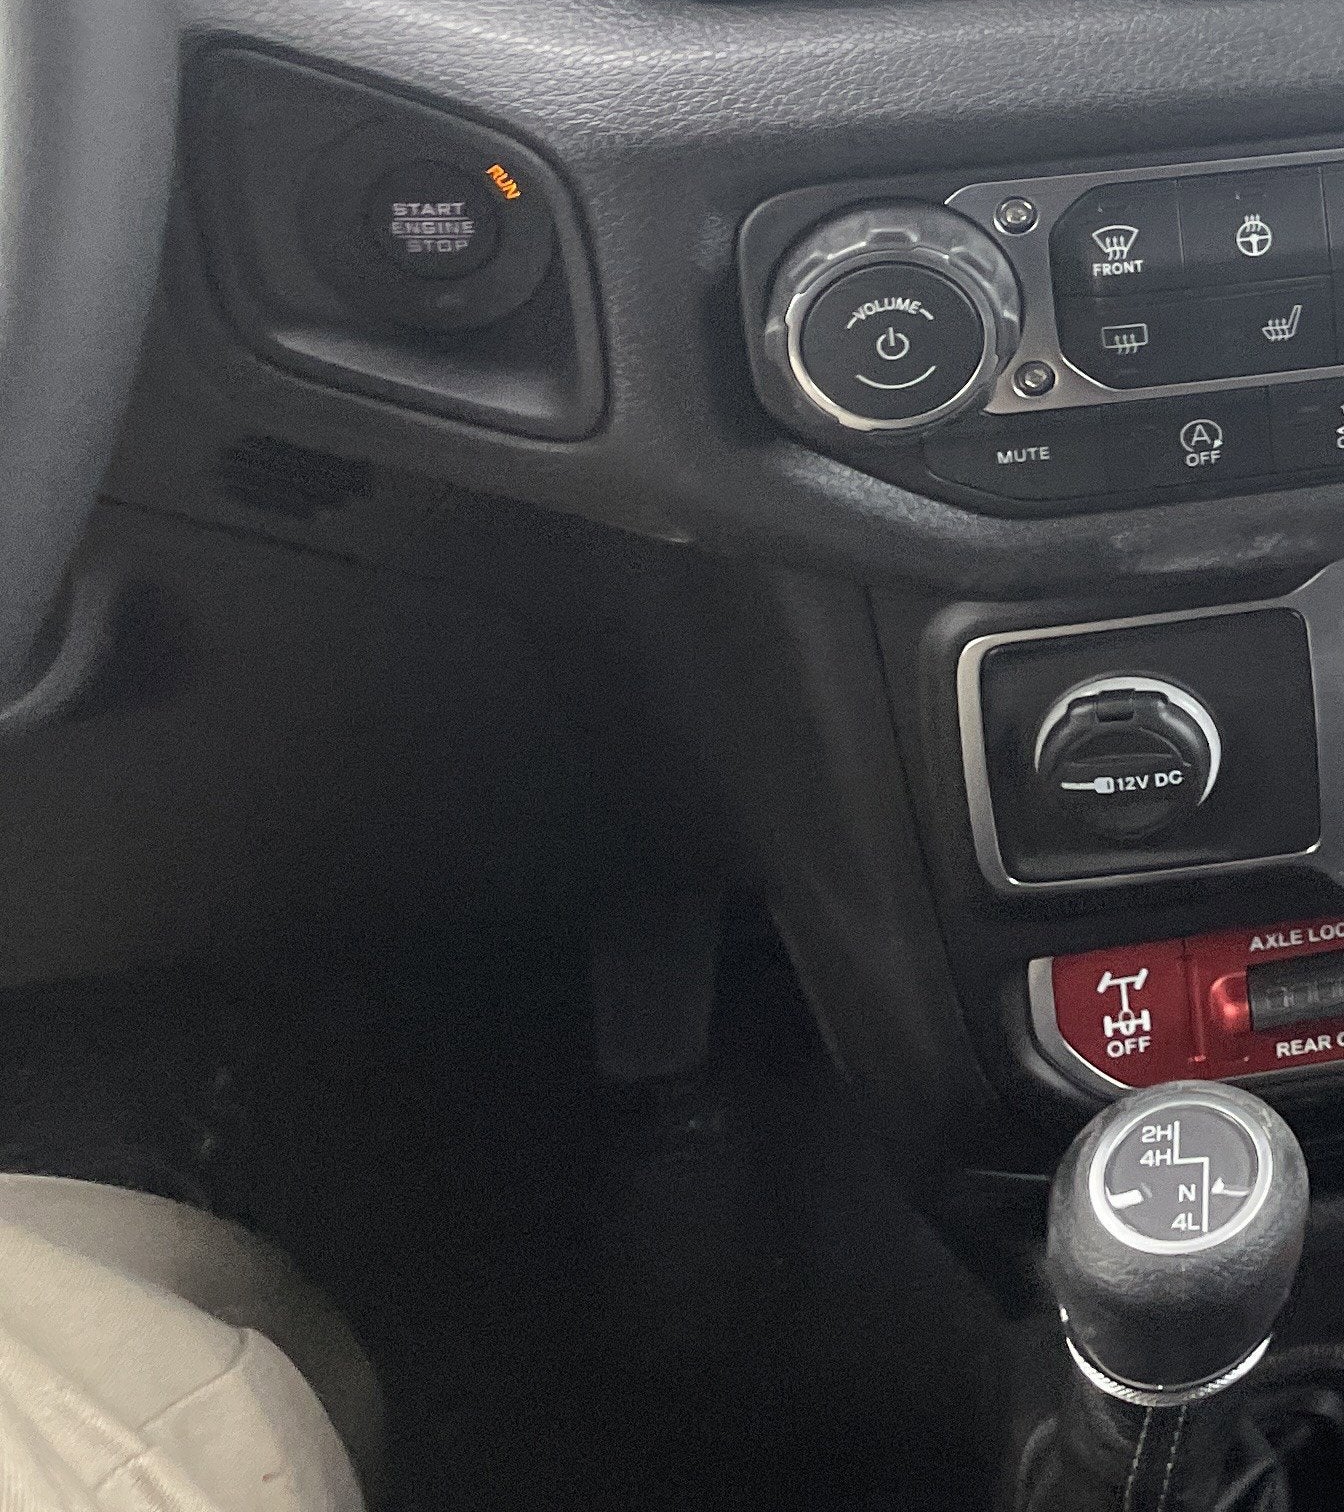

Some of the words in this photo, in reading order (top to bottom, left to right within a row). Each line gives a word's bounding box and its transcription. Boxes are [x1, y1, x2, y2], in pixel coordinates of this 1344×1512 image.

[485, 164, 522, 200] RUN
[392, 201, 466, 218] START
[391, 219, 476, 235] ENGINE
[405, 238, 469, 254] STOP
[1092, 258, 1144, 277] FRONT
[852, 296, 924, 319] VOLUME
[997, 446, 1050, 465] MUTE
[1186, 448, 1221, 467] OFF
[1114, 774, 1149, 793] 12V
[1154, 770, 1185, 787] DC
[1249, 929, 1304, 953] AXLE
[1106, 1036, 1152, 1058] OFF
[1276, 1036, 1331, 1059] REAR
[1141, 1124, 1173, 1143] 2H
[1140, 1148, 1172, 1167] 4H
[1178, 1183, 1197, 1203] N
[1170, 1212, 1200, 1231] 4L
